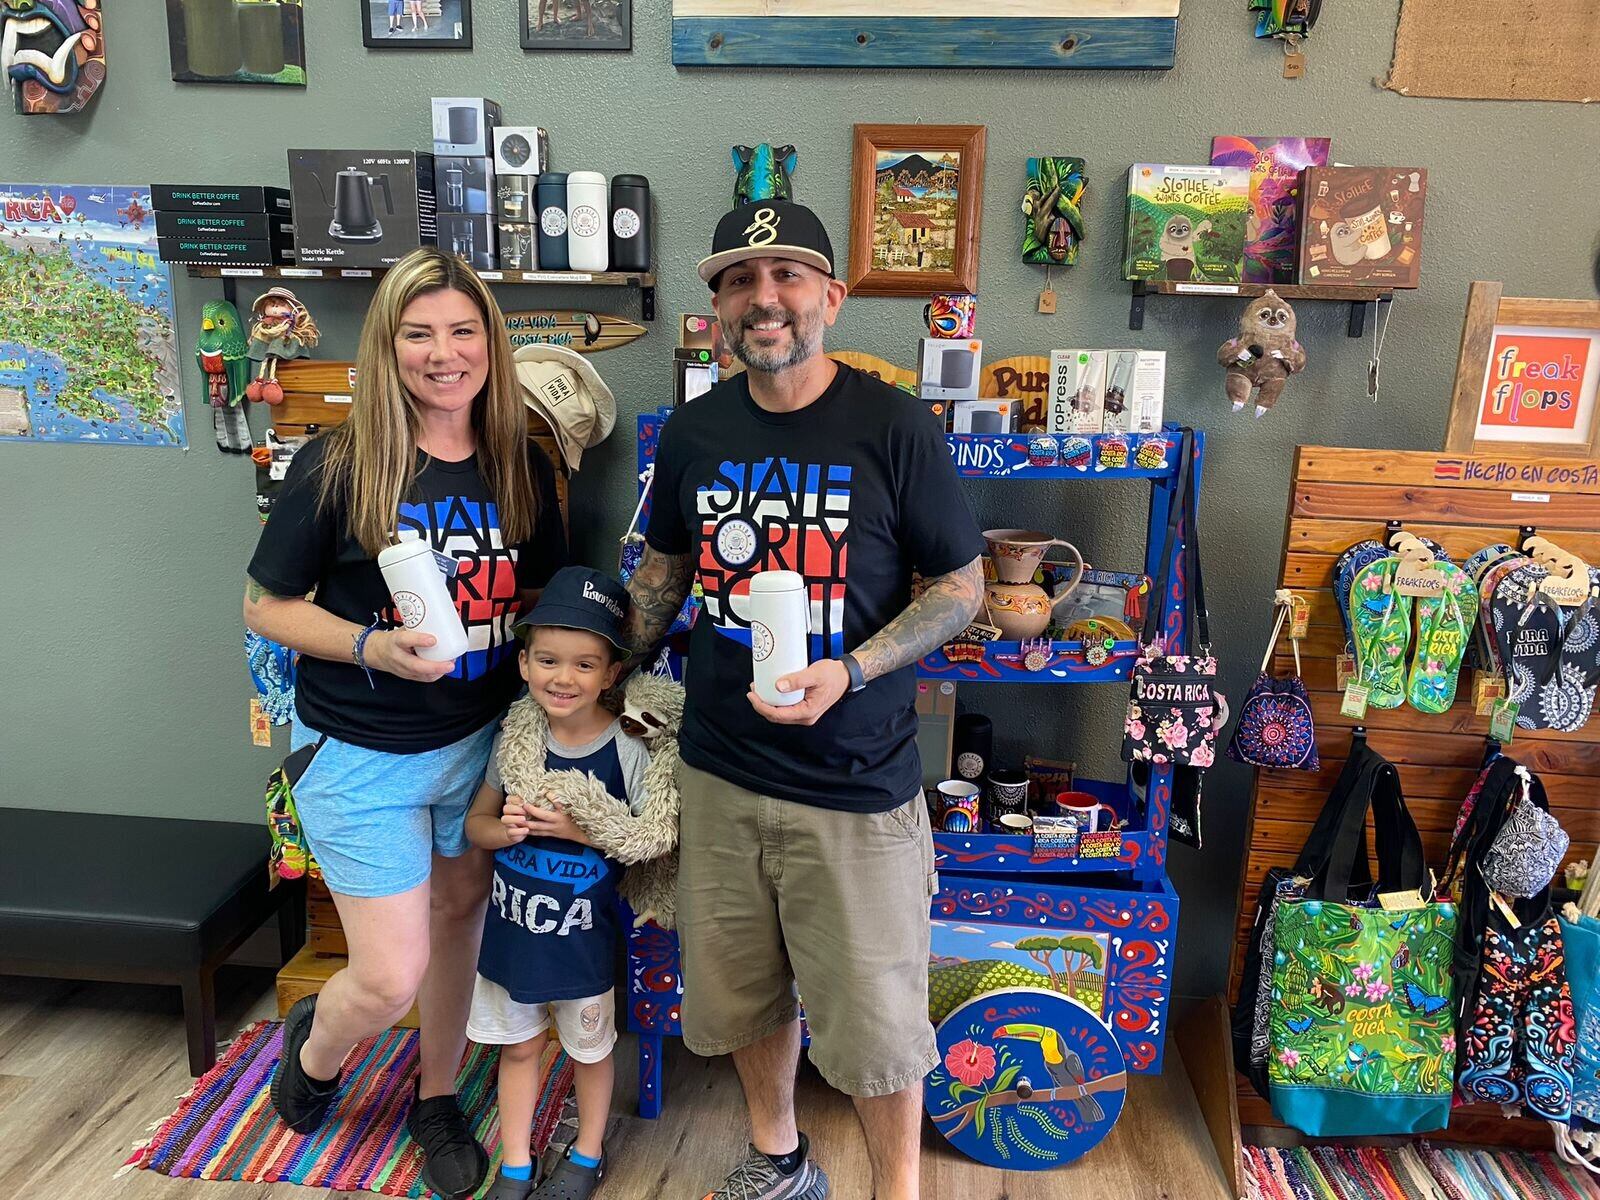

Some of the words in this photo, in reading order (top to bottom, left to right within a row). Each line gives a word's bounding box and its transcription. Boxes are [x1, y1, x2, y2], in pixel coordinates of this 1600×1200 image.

[1158, 177, 1209, 193] SLOTHEE
[1335, 178, 1375, 206] SLOTHEE
[191, 192, 215, 200] BETTER
[1155, 193, 1181, 204] WANTS
[1183, 192, 1222, 206] COFFEE
[1359, 226, 1386, 244] COFFEE
[529, 314, 557, 329] VIDA
[510, 334, 543, 346] COSTA
[547, 332, 574, 345] RICA
[1497, 346, 1581, 380] freak
[554, 377, 571, 397] PURA
[993, 365, 1049, 396] Pur
[546, 384, 562, 401] VIDA
[1053, 365, 1068, 433] roPress
[1492, 381, 1572, 422] flops
[1464, 462, 1517, 481] HECHO
[1521, 466, 1543, 483] EN
[1547, 466, 1599, 485] COSTA
[1096, 570, 1116, 585] RICA
[1434, 641, 1463, 656] RICA
[1512, 642, 1549, 658] VIDA
[1138, 682, 1182, 700] COSTA
[1184, 683, 1210, 701] RICA
[546, 857, 599, 880] VIDA
[491, 869, 594, 936] RICA
[1346, 1002, 1393, 1022] COSTA
[1352, 1019, 1387, 1040] RICA
